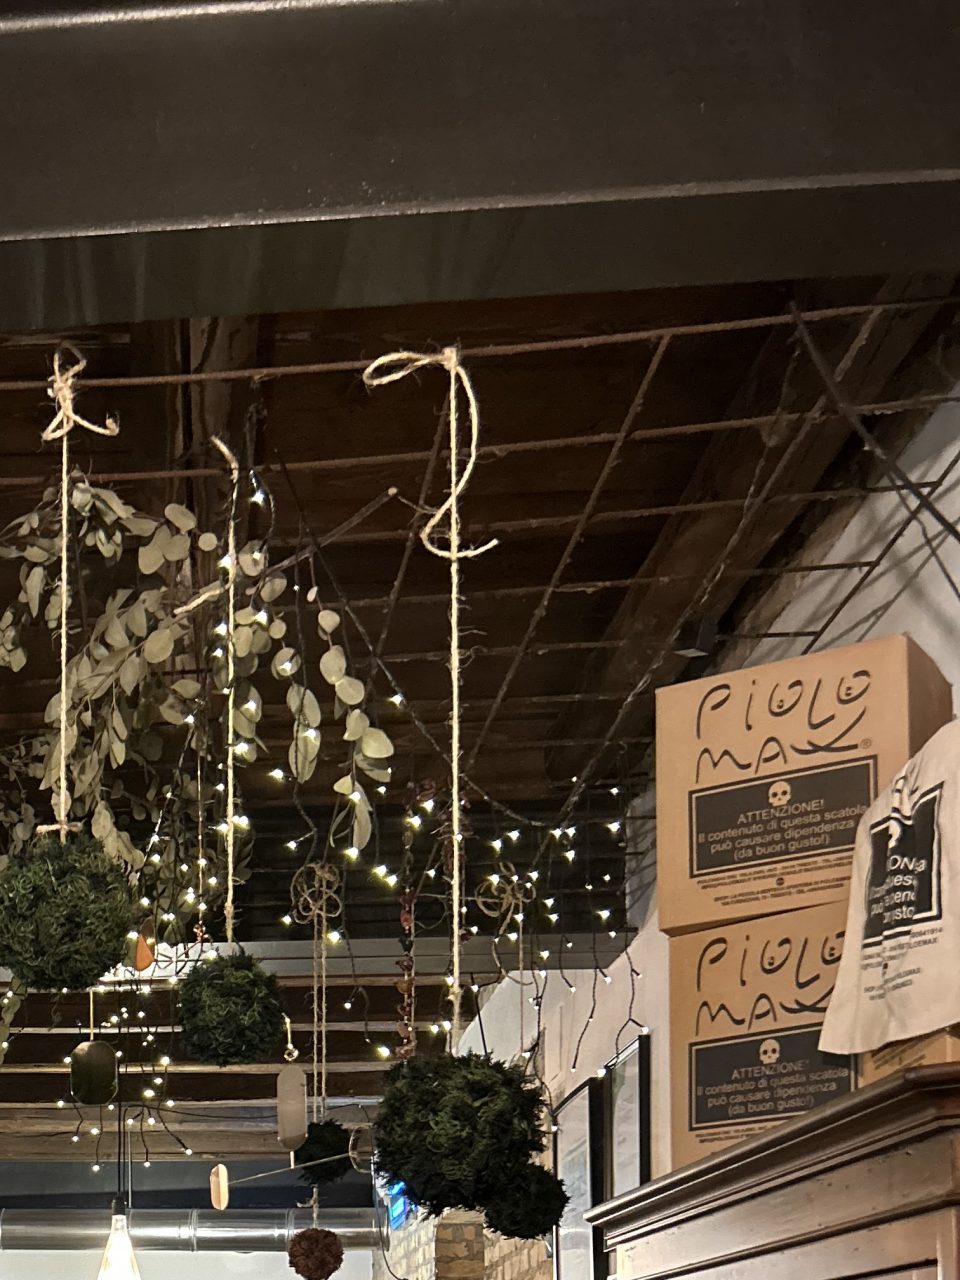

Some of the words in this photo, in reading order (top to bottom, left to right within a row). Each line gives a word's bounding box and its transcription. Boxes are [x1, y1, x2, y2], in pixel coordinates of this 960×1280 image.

[708, 823, 763, 842] contenuto
[767, 818, 777, 830] di
[780, 813, 820, 830] questa
[823, 804, 868, 821] scatola
[737, 799, 825, 825] ATTENZIONE!
[710, 839, 733, 854] può
[735, 832, 781, 849] causare
[784, 818, 855, 842] dipendenza
[733, 848, 753, 862] (da
[755, 843, 785, 857] buon
[788, 835, 831, 854] gusto!)
[705, 1079, 756, 1095] contenuto
[758, 1076, 768, 1087] di
[770, 1070, 807, 1087] questa
[809, 1066, 849, 1082] scatola
[707, 1095, 728, 1108] può
[729, 1088, 772, 1104] causare
[773, 1080, 837, 1101] dipendenza
[748, 1099, 775, 1113] buon
